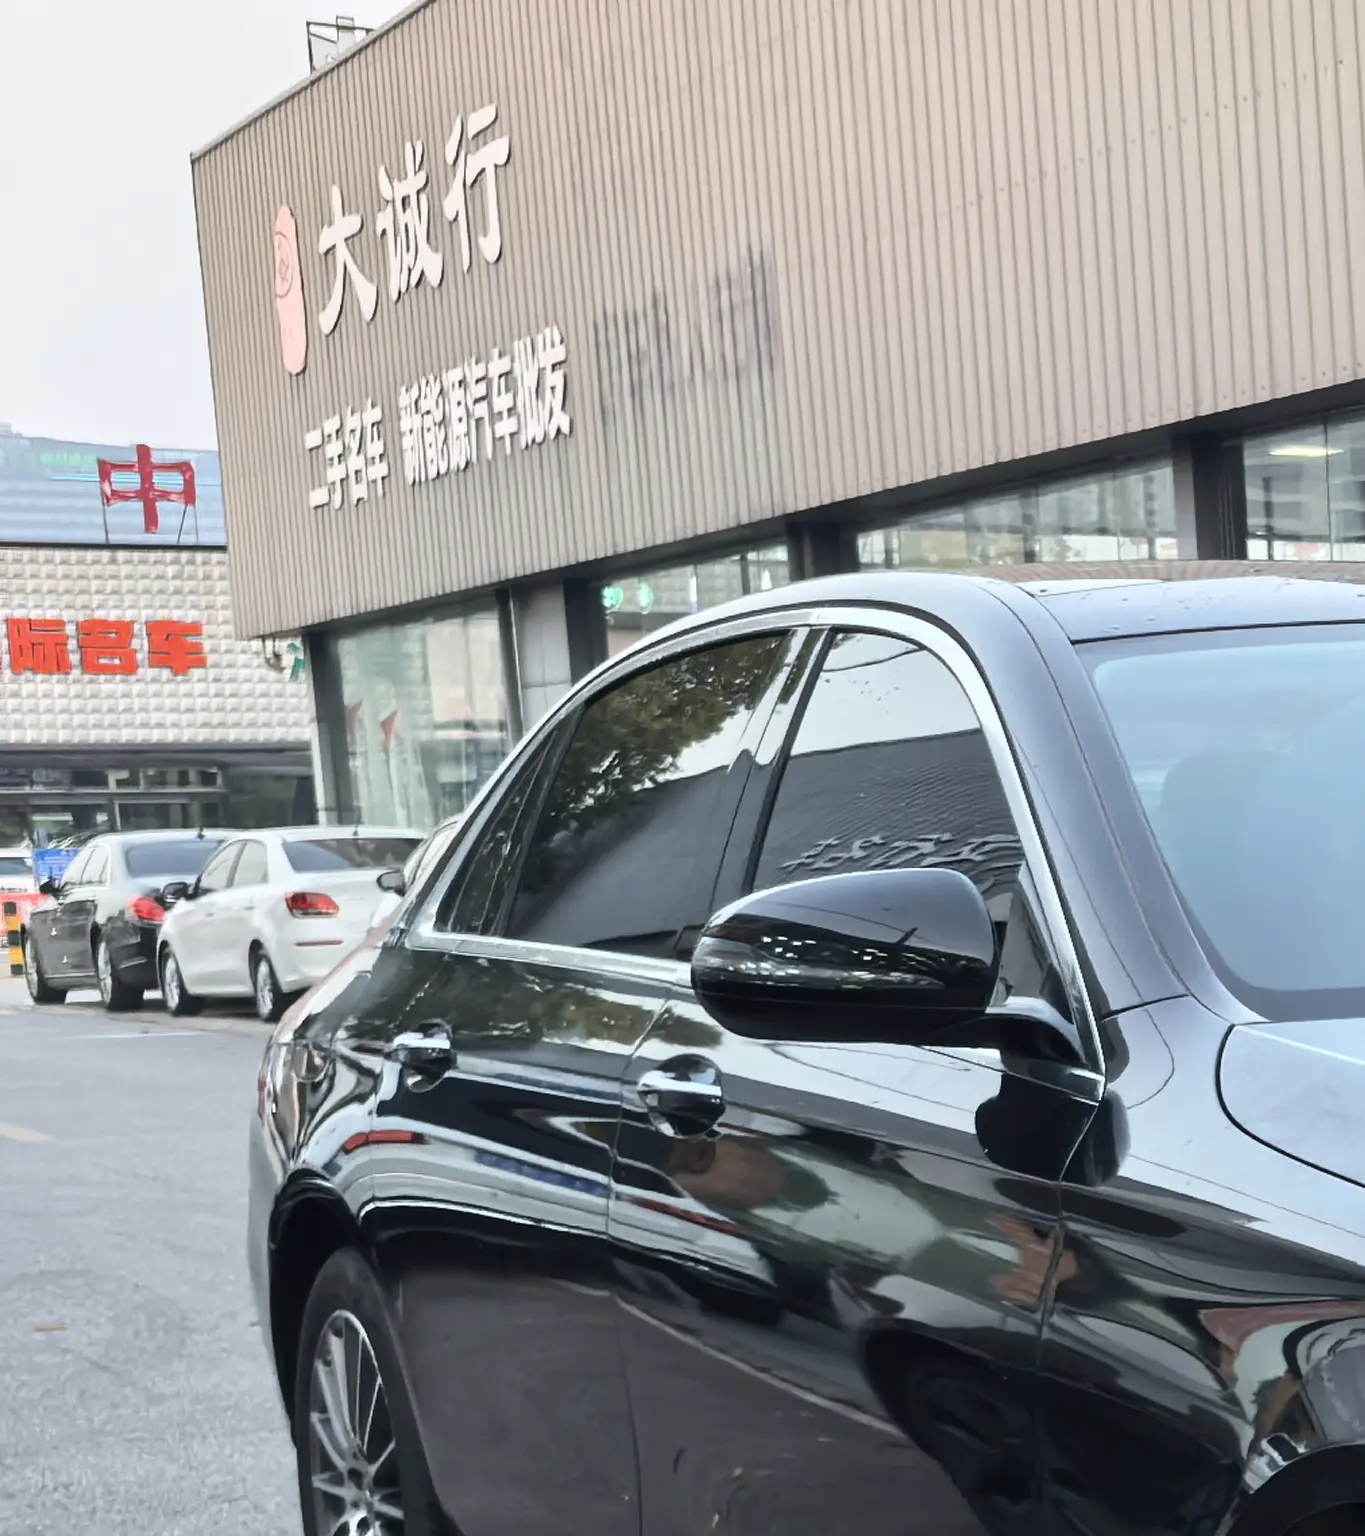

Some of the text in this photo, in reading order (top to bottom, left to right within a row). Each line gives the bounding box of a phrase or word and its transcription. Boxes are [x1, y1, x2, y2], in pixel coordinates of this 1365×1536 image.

[318, 103, 510, 336] 大诚行
[305, 398, 390, 511] 二手名车
[398, 324, 574, 486] 新能源汽车批发
[97, 443, 196, 534] 中
[7, 618, 207, 676] 际名车
